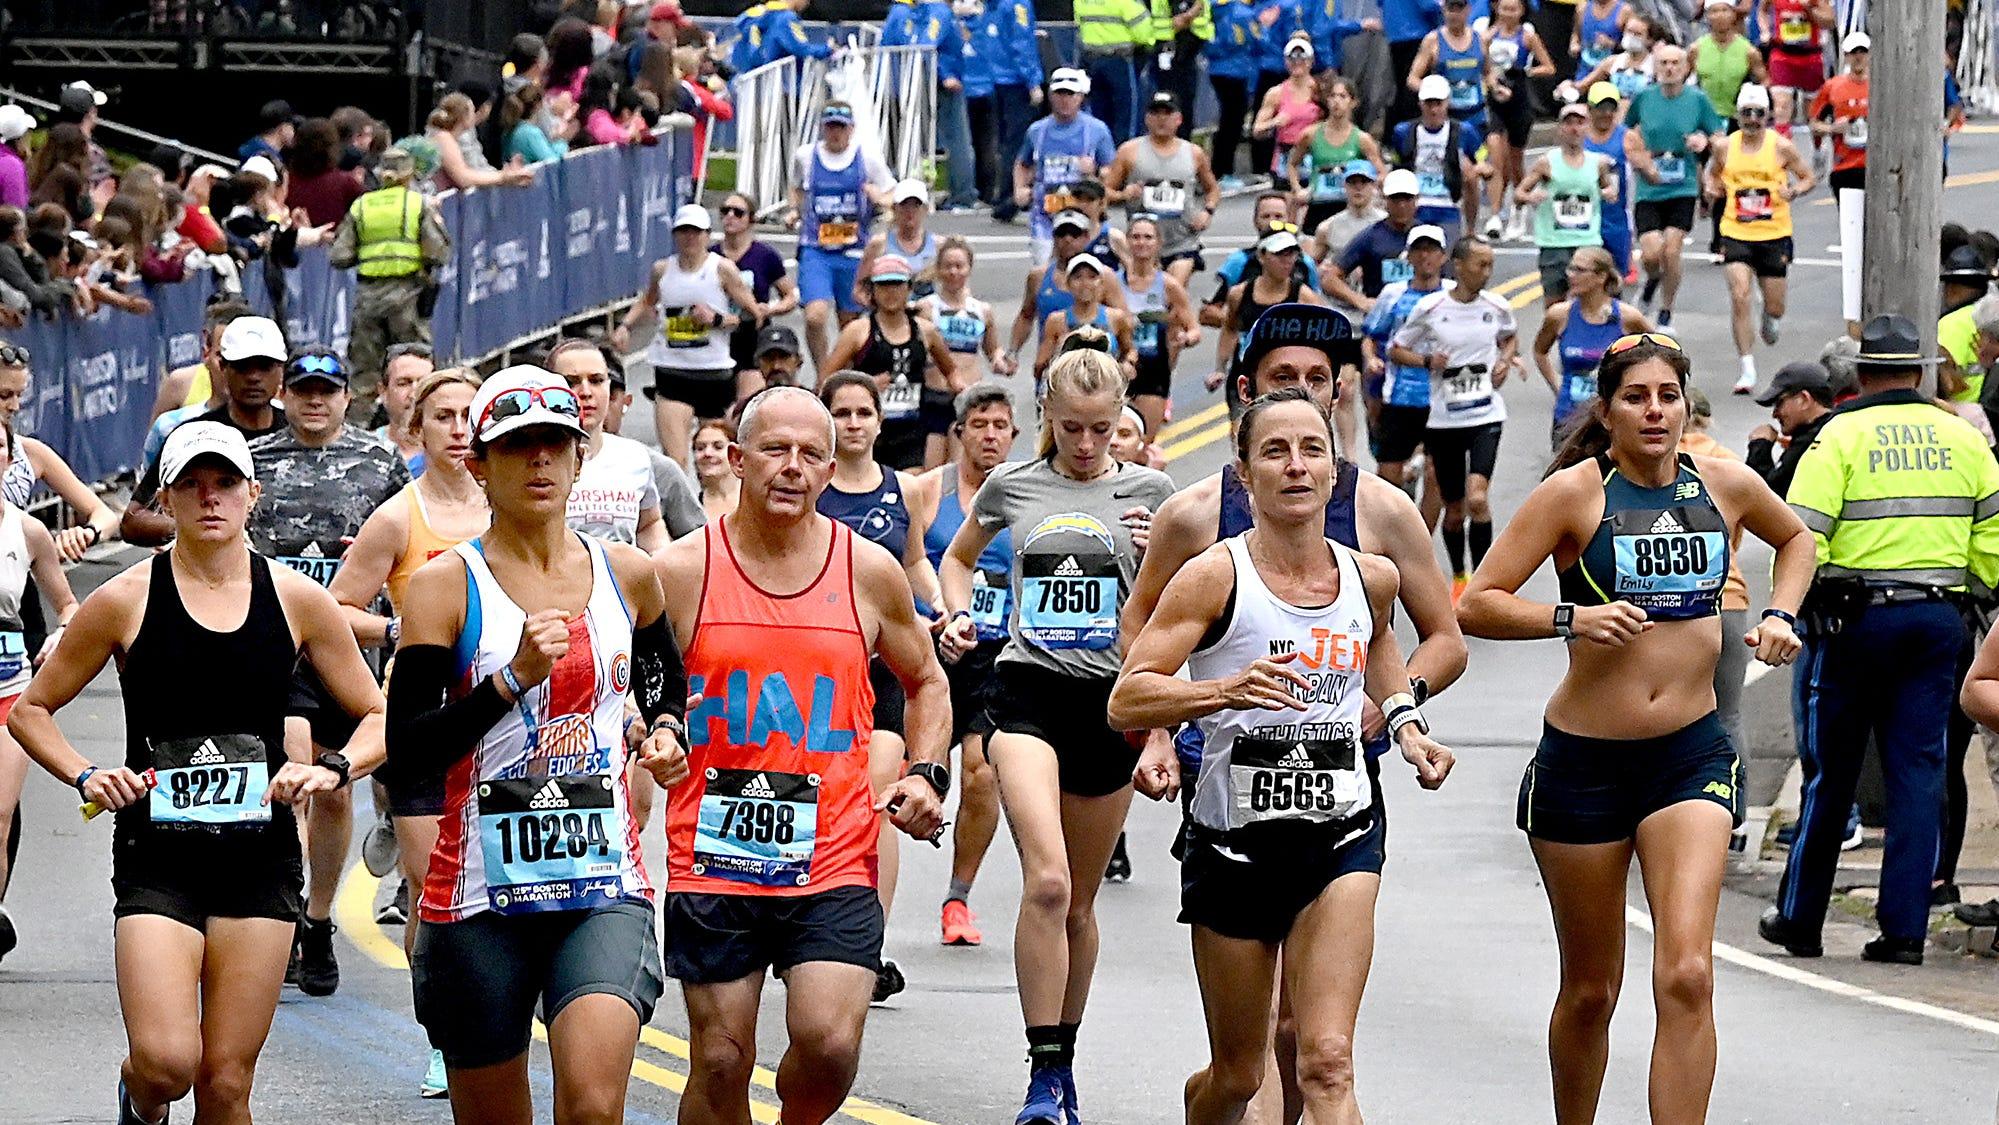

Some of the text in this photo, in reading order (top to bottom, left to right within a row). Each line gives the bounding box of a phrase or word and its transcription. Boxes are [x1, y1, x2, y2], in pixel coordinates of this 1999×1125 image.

[1875, 424, 1939, 446] STATE
[1868, 447, 1952, 473] POLICE
[1634, 535, 1708, 577] 8930
[973, 588, 996, 613] 96
[1037, 580, 1100, 614] 7850
[1269, 639, 1295, 656] NYC
[1299, 627, 1367, 673] JEN
[688, 668, 857, 752] HAL
[1249, 721, 1354, 741] ATHLETICS
[190, 754, 226, 765] adidas
[1277, 759, 1314, 769] adidas
[170, 766, 249, 809] 8227
[741, 788, 776, 799] adidas
[1251, 770, 1336, 812] 6563
[529, 797, 569, 810] adidas
[717, 800, 796, 845] 7398
[495, 812, 610, 865] 10284
[713, 862, 763, 874] MARATHON
[730, 857, 763, 867] BOSTON
[513, 891, 573, 902] MARATHON
[533, 883, 570, 894] BOSTON
